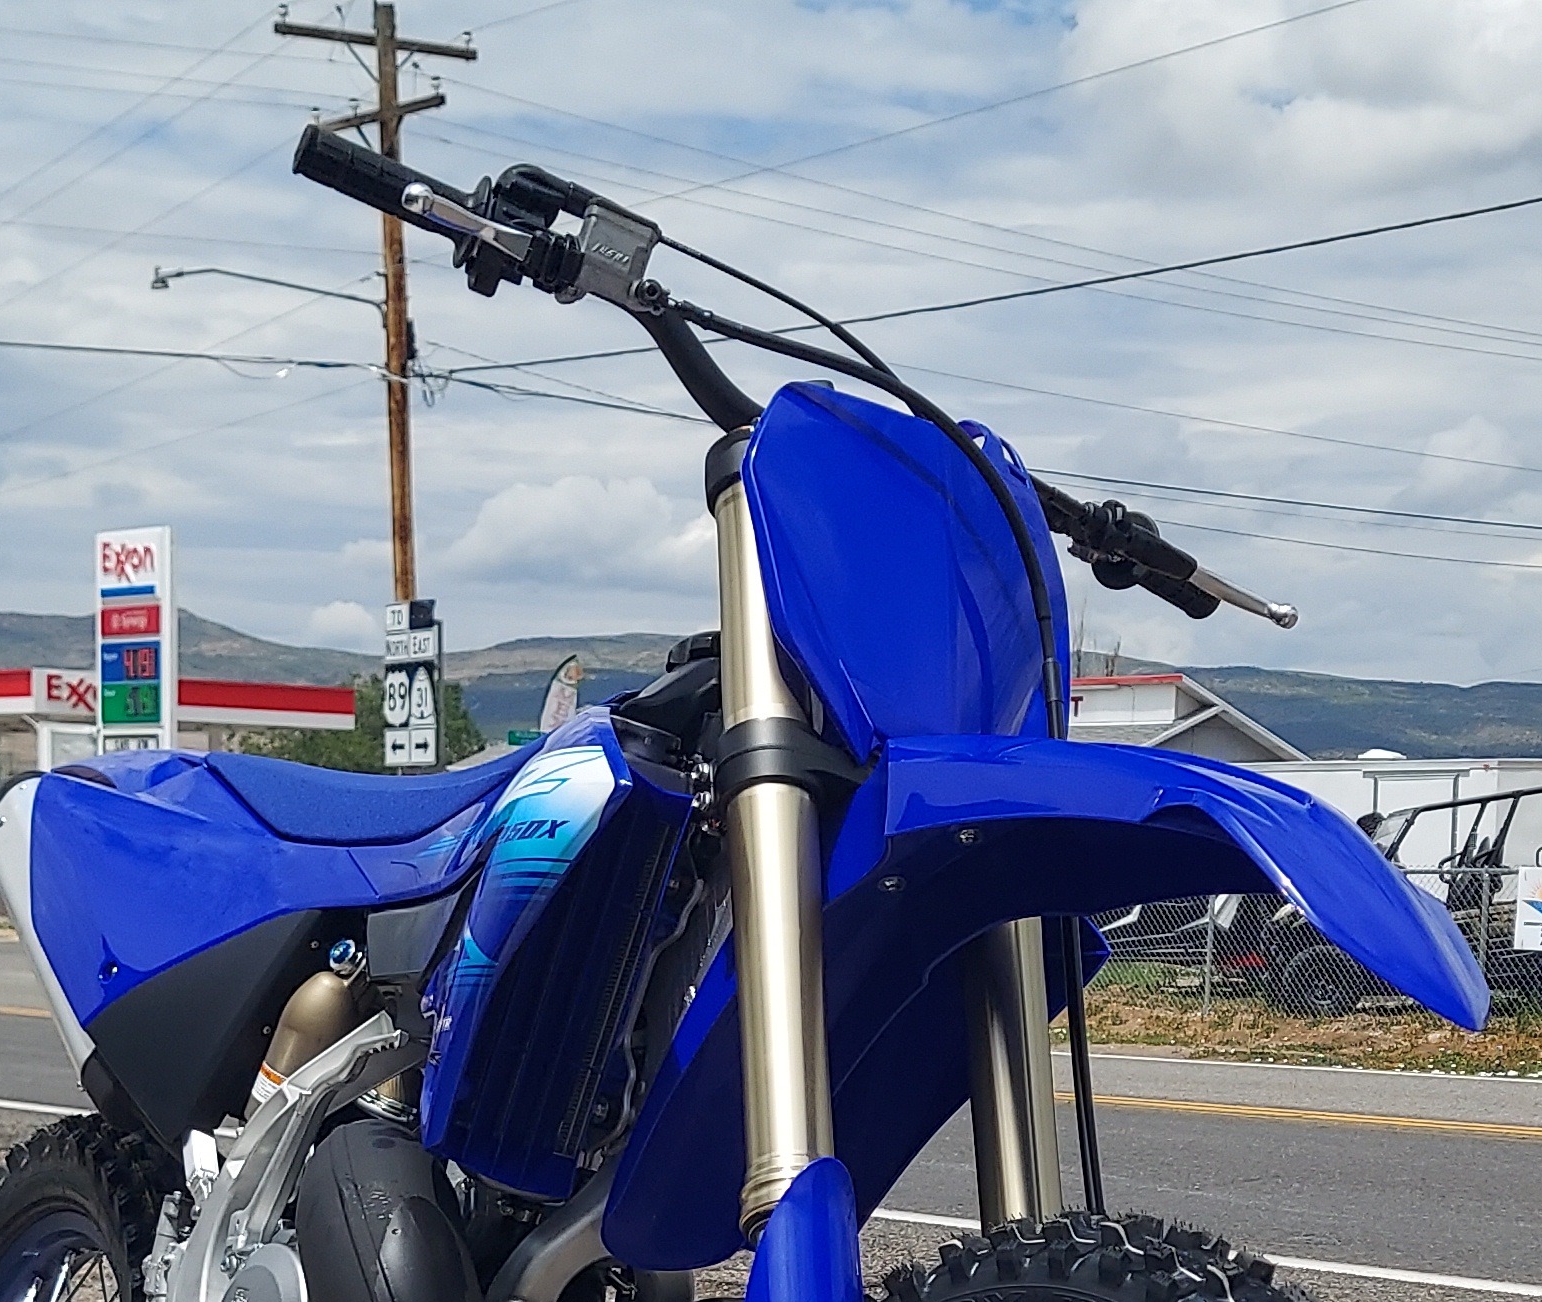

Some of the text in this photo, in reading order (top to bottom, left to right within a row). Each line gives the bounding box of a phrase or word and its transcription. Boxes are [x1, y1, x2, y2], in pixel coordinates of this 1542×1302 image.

[390, 609, 404, 626] TO
[386, 639, 408, 656] NORTH
[412, 635, 431, 655] EAST
[45, 673, 97, 713] Exx
[388, 681, 408, 712] 89
[416, 686, 428, 709] 31
